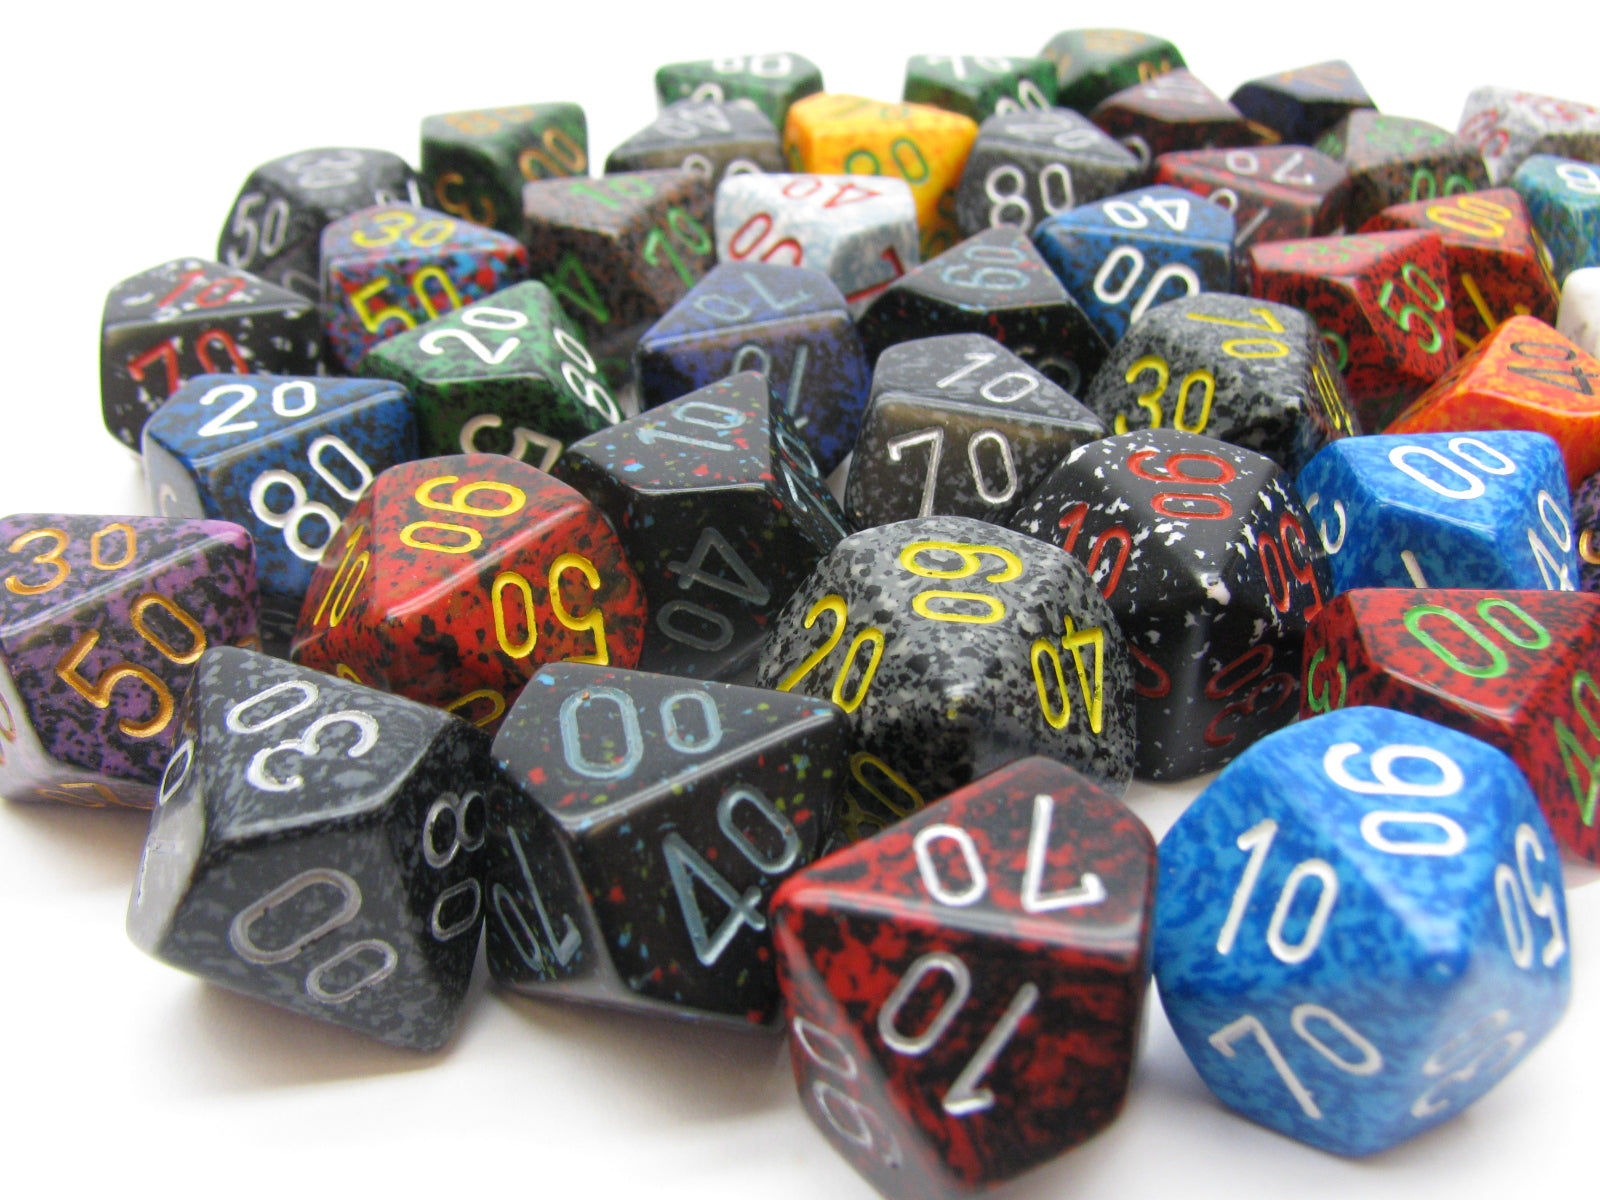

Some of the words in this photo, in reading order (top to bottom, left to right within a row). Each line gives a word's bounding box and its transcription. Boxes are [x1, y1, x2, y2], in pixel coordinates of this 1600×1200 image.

[568, 178, 655, 209] 10
[782, 174, 884, 211] 40
[985, 162, 1075, 236] 80
[1103, 195, 1191, 231] 40
[1225, 149, 1313, 187] 70
[226, 191, 289, 269] 50
[352, 209, 457, 249] 30
[644, 207, 712, 289] 70
[1426, 195, 1512, 238] 00
[157, 269, 247, 309] 10
[350, 265, 462, 334] 50
[1377, 261, 1445, 355] 50
[127, 328, 249, 394] 70
[418, 306, 529, 366] 20
[553, 327, 622, 425] 80
[936, 351, 1040, 403] 10
[1507, 341, 1600, 396] 40
[197, 380, 317, 437] 20
[636, 400, 746, 454] 10
[1115, 354, 1216, 436] 30
[250, 434, 375, 562] 80
[888, 426, 1018, 518] 70
[1388, 436, 1518, 500] 00
[5, 521, 138, 596] 30
[312, 524, 370, 629] 10
[655, 527, 771, 652] 40
[1058, 502, 1132, 600] 10
[1258, 511, 1323, 622] 50
[491, 552, 611, 665] 50
[774, 593, 885, 715] 20
[1403, 598, 1551, 679] 00
[56, 591, 208, 738] 50
[1031, 613, 1104, 735] 40
[1202, 644, 1296, 747] 30
[227, 679, 380, 793] 30
[559, 686, 724, 780] 00
[422, 791, 487, 943] 80
[662, 783, 801, 967] 40
[912, 793, 1108, 914] 70
[1215, 818, 1339, 965] 10
[1494, 822, 1566, 970] 50
[229, 867, 399, 1004] 00
[877, 950, 1042, 1118] 10
[1208, 1003, 1384, 1120] 70
